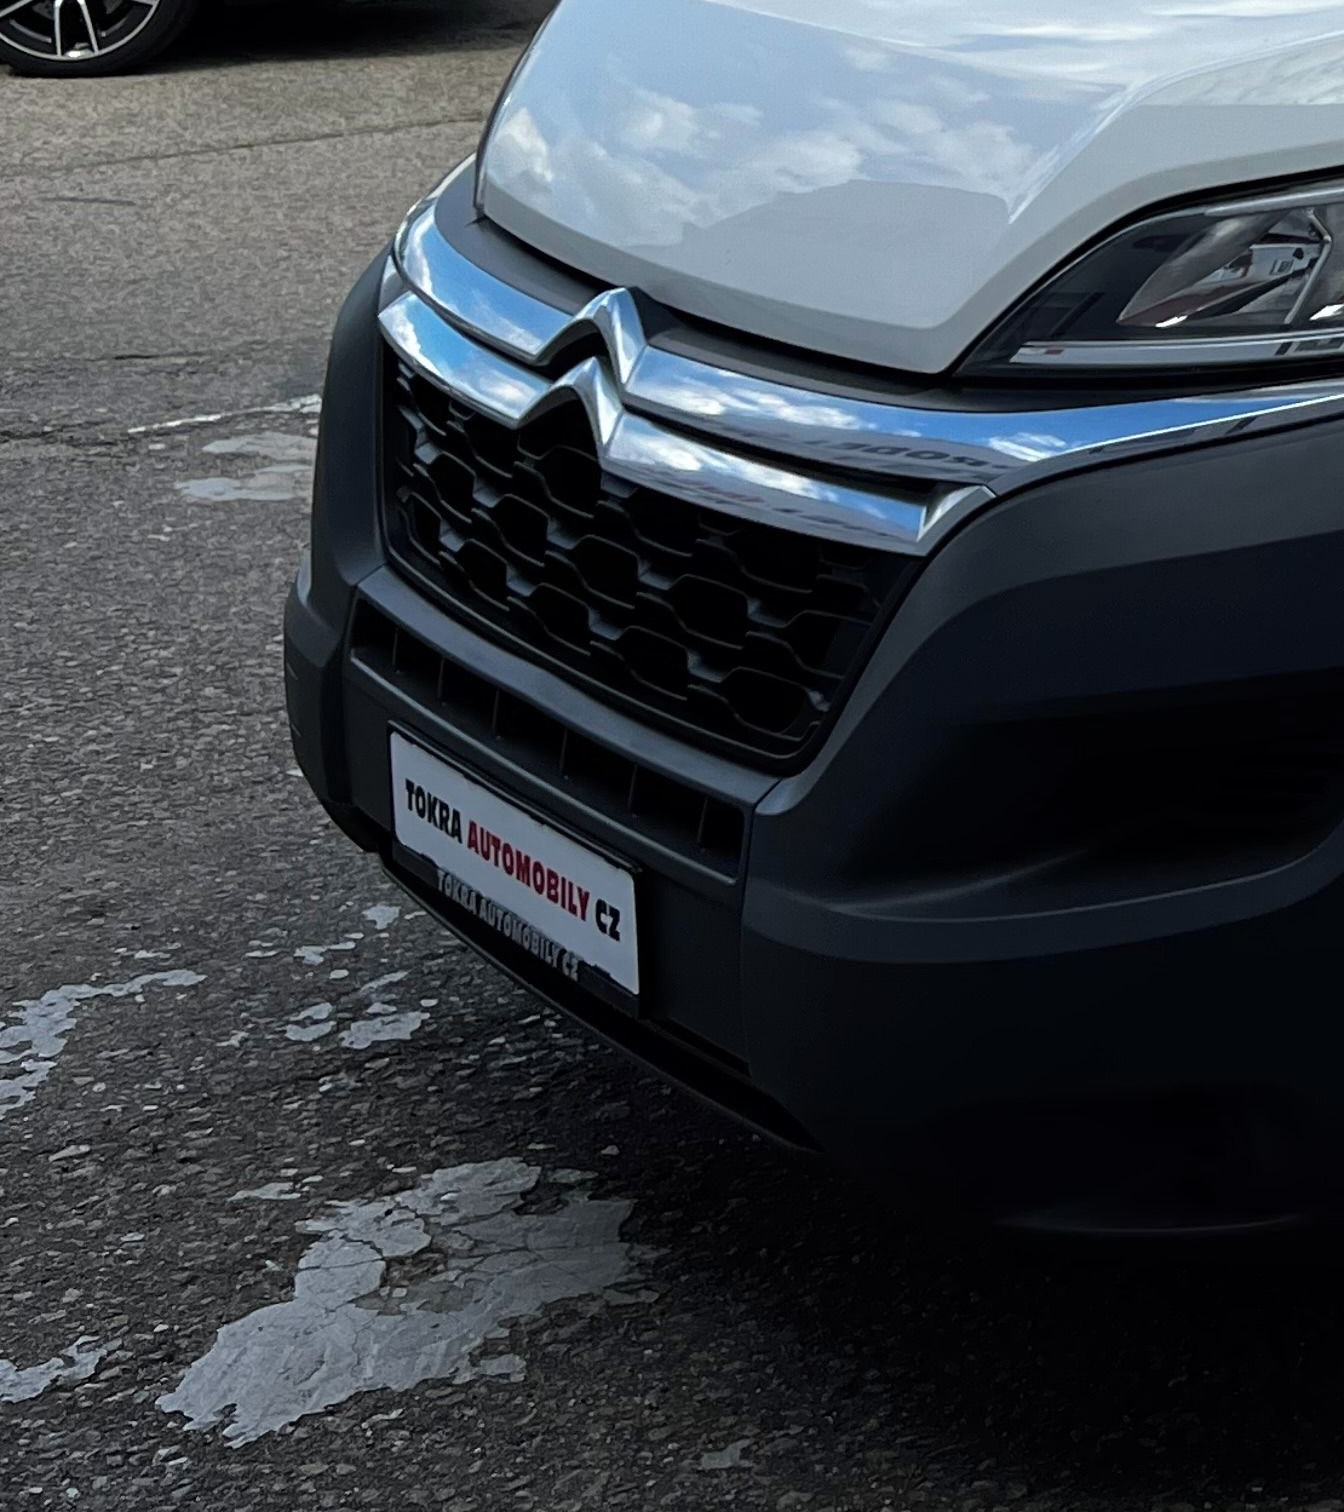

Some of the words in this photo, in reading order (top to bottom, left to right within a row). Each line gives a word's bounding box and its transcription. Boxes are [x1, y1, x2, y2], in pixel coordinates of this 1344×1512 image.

[405, 777, 463, 844] TOKRA
[467, 819, 590, 922] AUTOMOBILY
[595, 898, 621, 942] CZ
[437, 869, 477, 916] TOKRA
[478, 898, 561, 969] AUTOMOBILY
[562, 951, 579, 982] CZ
